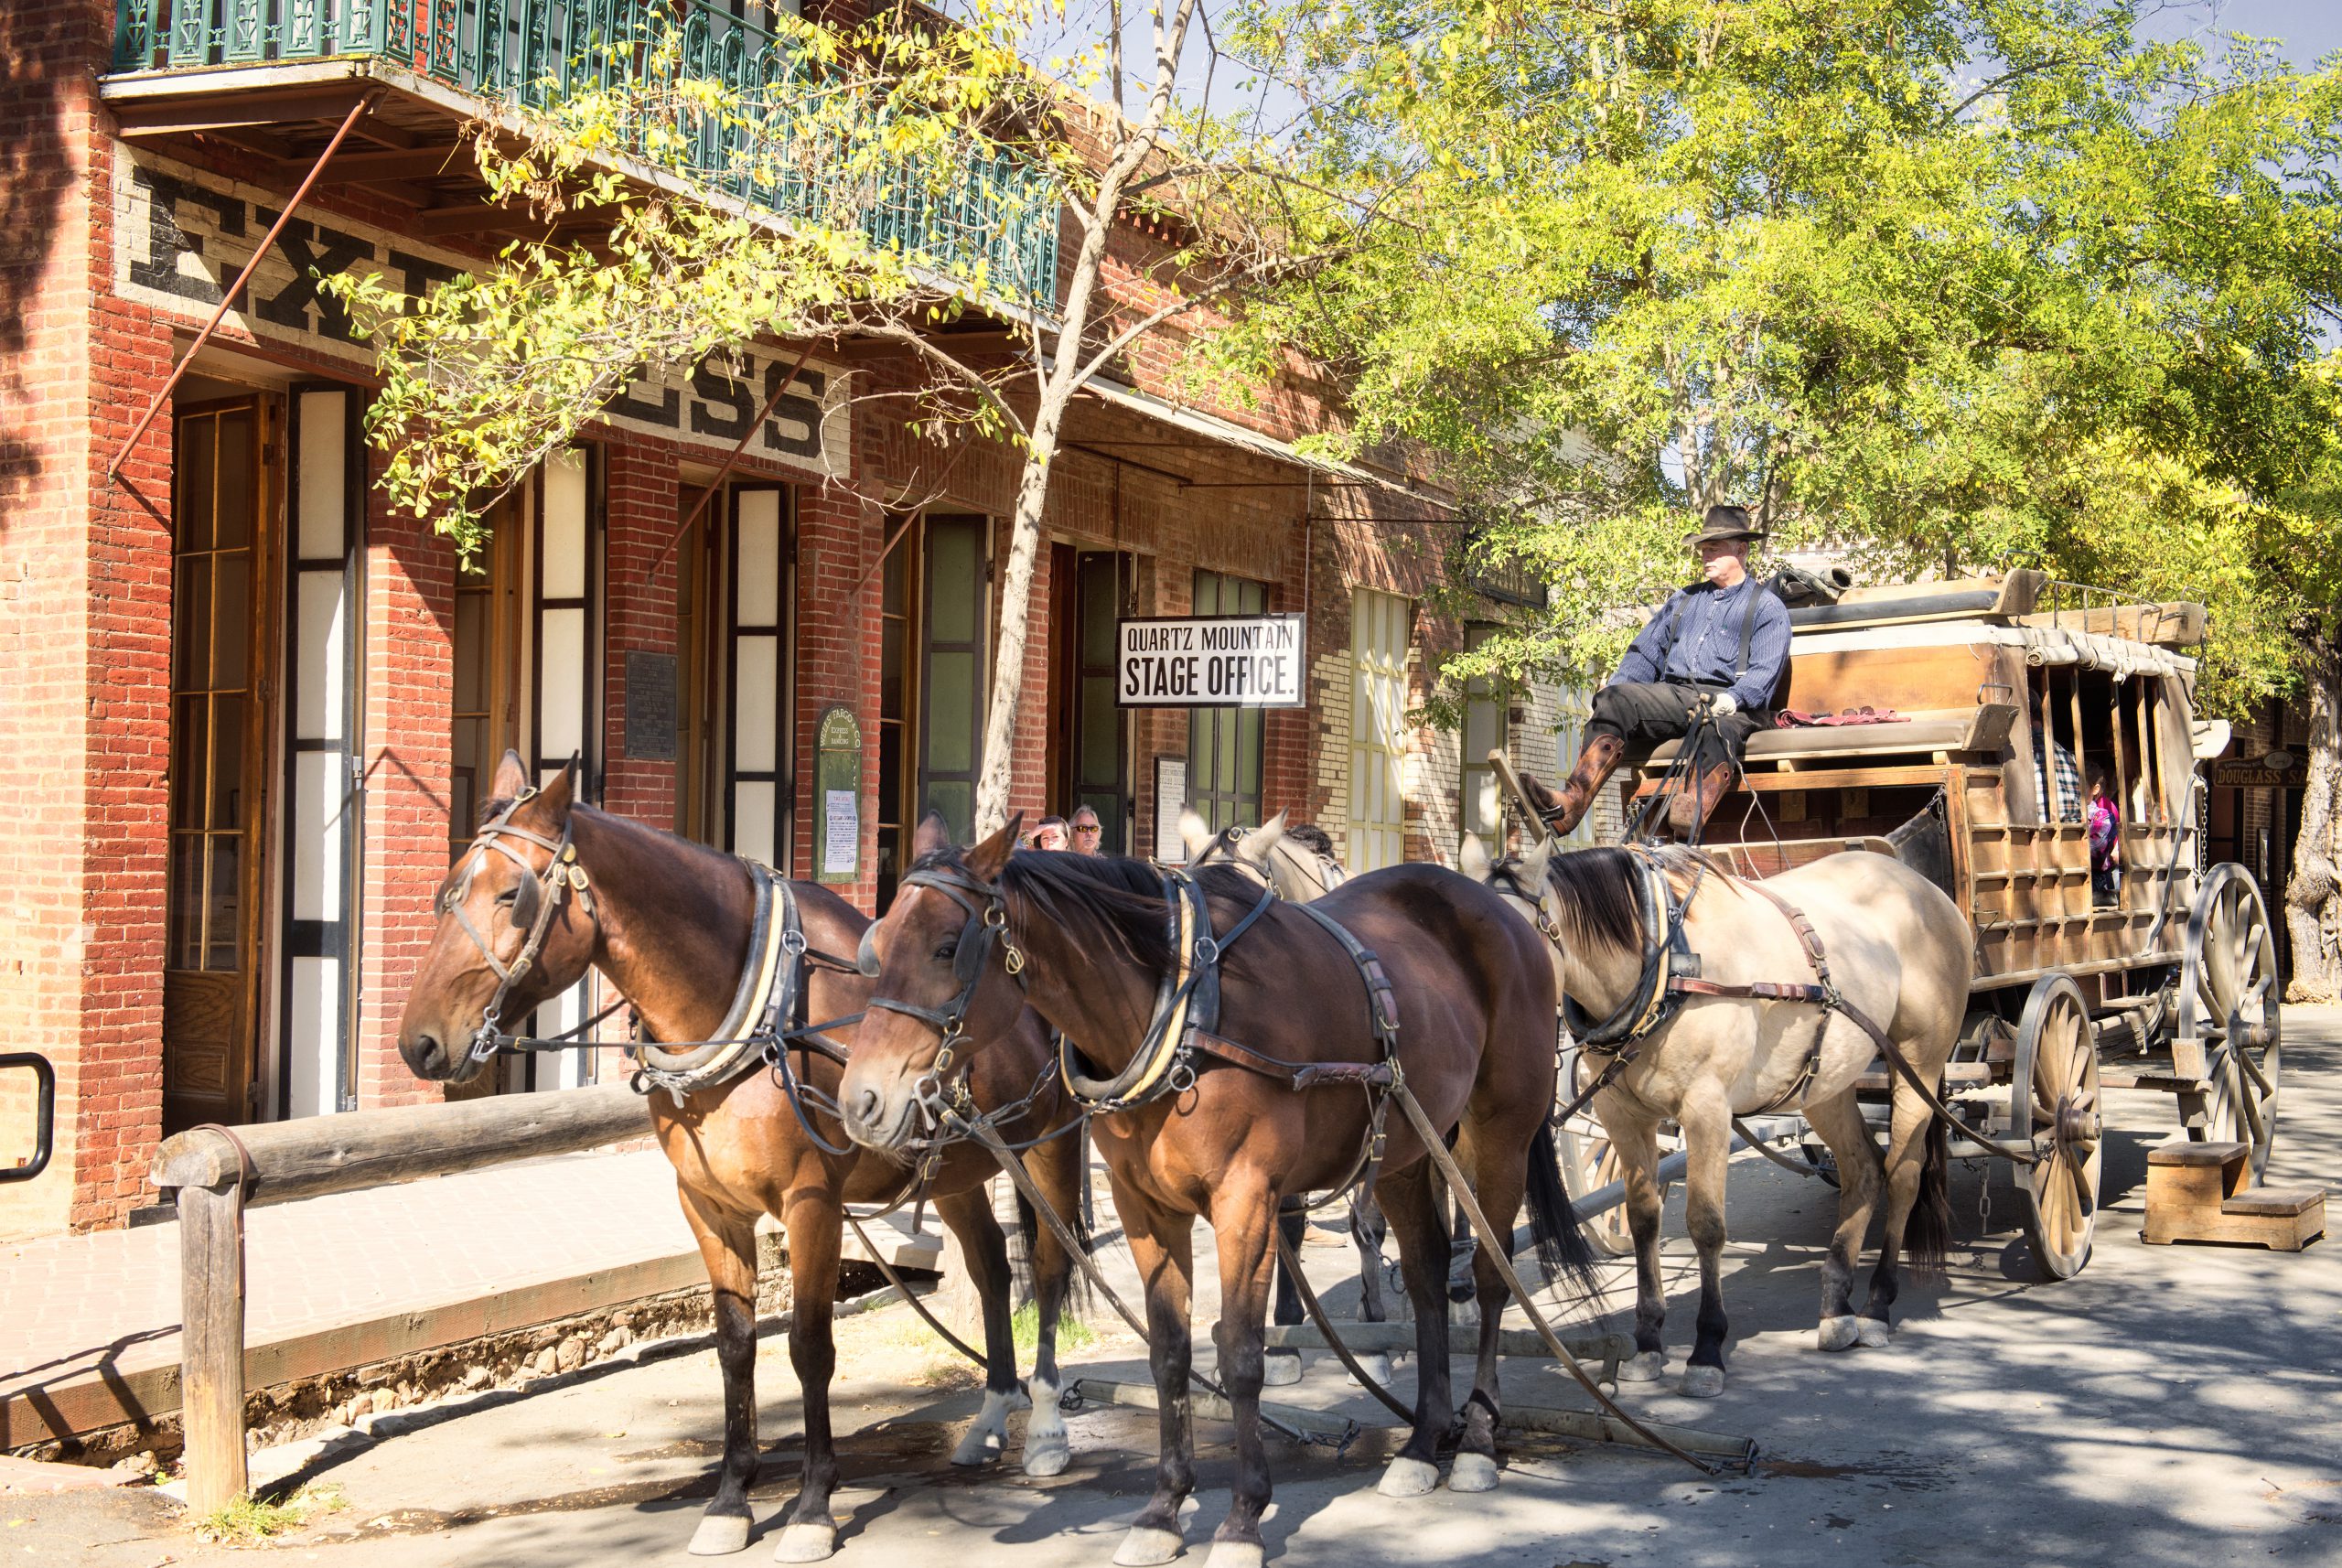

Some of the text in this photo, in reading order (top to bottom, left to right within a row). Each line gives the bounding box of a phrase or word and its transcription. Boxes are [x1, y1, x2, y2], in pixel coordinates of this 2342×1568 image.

[1127, 625, 1293, 652] QUARTZ MOUNTAIN
[1125, 655, 1295, 697] STAGE OFFICE.
[820, 714, 832, 747] WELLS
[832, 708, 853, 723] FARGO
[2218, 769, 2283, 784] DOUGLASS
